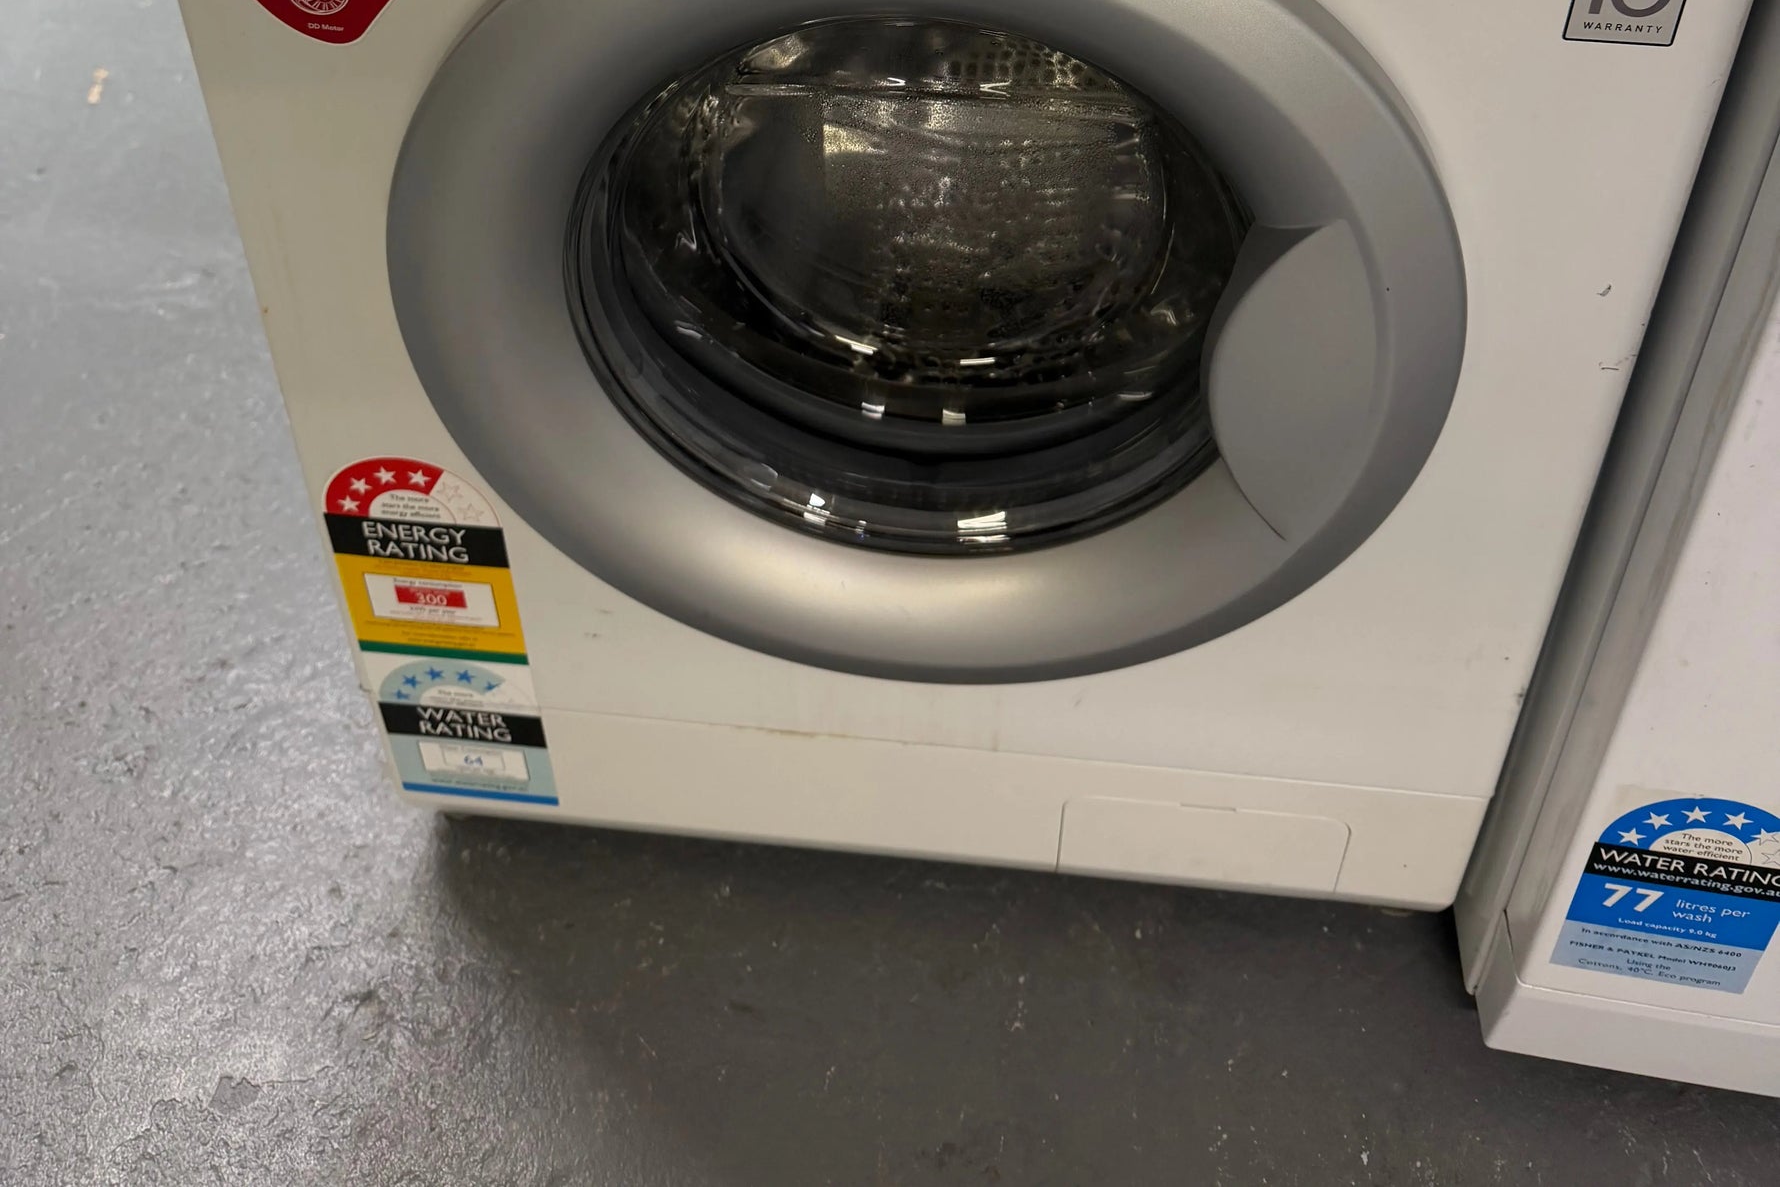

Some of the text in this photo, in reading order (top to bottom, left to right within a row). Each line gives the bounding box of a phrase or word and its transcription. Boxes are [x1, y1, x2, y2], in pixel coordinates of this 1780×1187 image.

[307, 22, 344, 32] DD Motor
[1583, 21, 1662, 34] WARRANTY
[362, 521, 466, 546] ENERGY
[367, 539, 470, 564] RATING
[416, 706, 507, 728] WATER
[419, 720, 512, 742] RATING
[1664, 839, 1743, 854] stars the more
[1681, 832, 1733, 846] The more
[1600, 848, 1685, 873] WATER
[1663, 845, 1740, 861] water efficient
[1602, 882, 1664, 913] 77
[1672, 911, 1712, 923] wash
[1676, 899, 1751, 918] litres per
[1618, 917, 1643, 926] Load
[1644, 922, 1687, 934] capacity
[1705, 931, 1717, 939] kg
[1593, 930, 1649, 943] accordance
[1651, 939, 1673, 947] with
[1675, 943, 1715, 953] AS/NZS
[1569, 940, 1604, 950] FISHER
[1617, 948, 1655, 959] PAYKEL
[1658, 955, 1686, 964] Model
[1626, 958, 1653, 969] Using
[1658, 971, 1677, 979] Eco
[1679, 975, 1721, 986] program
